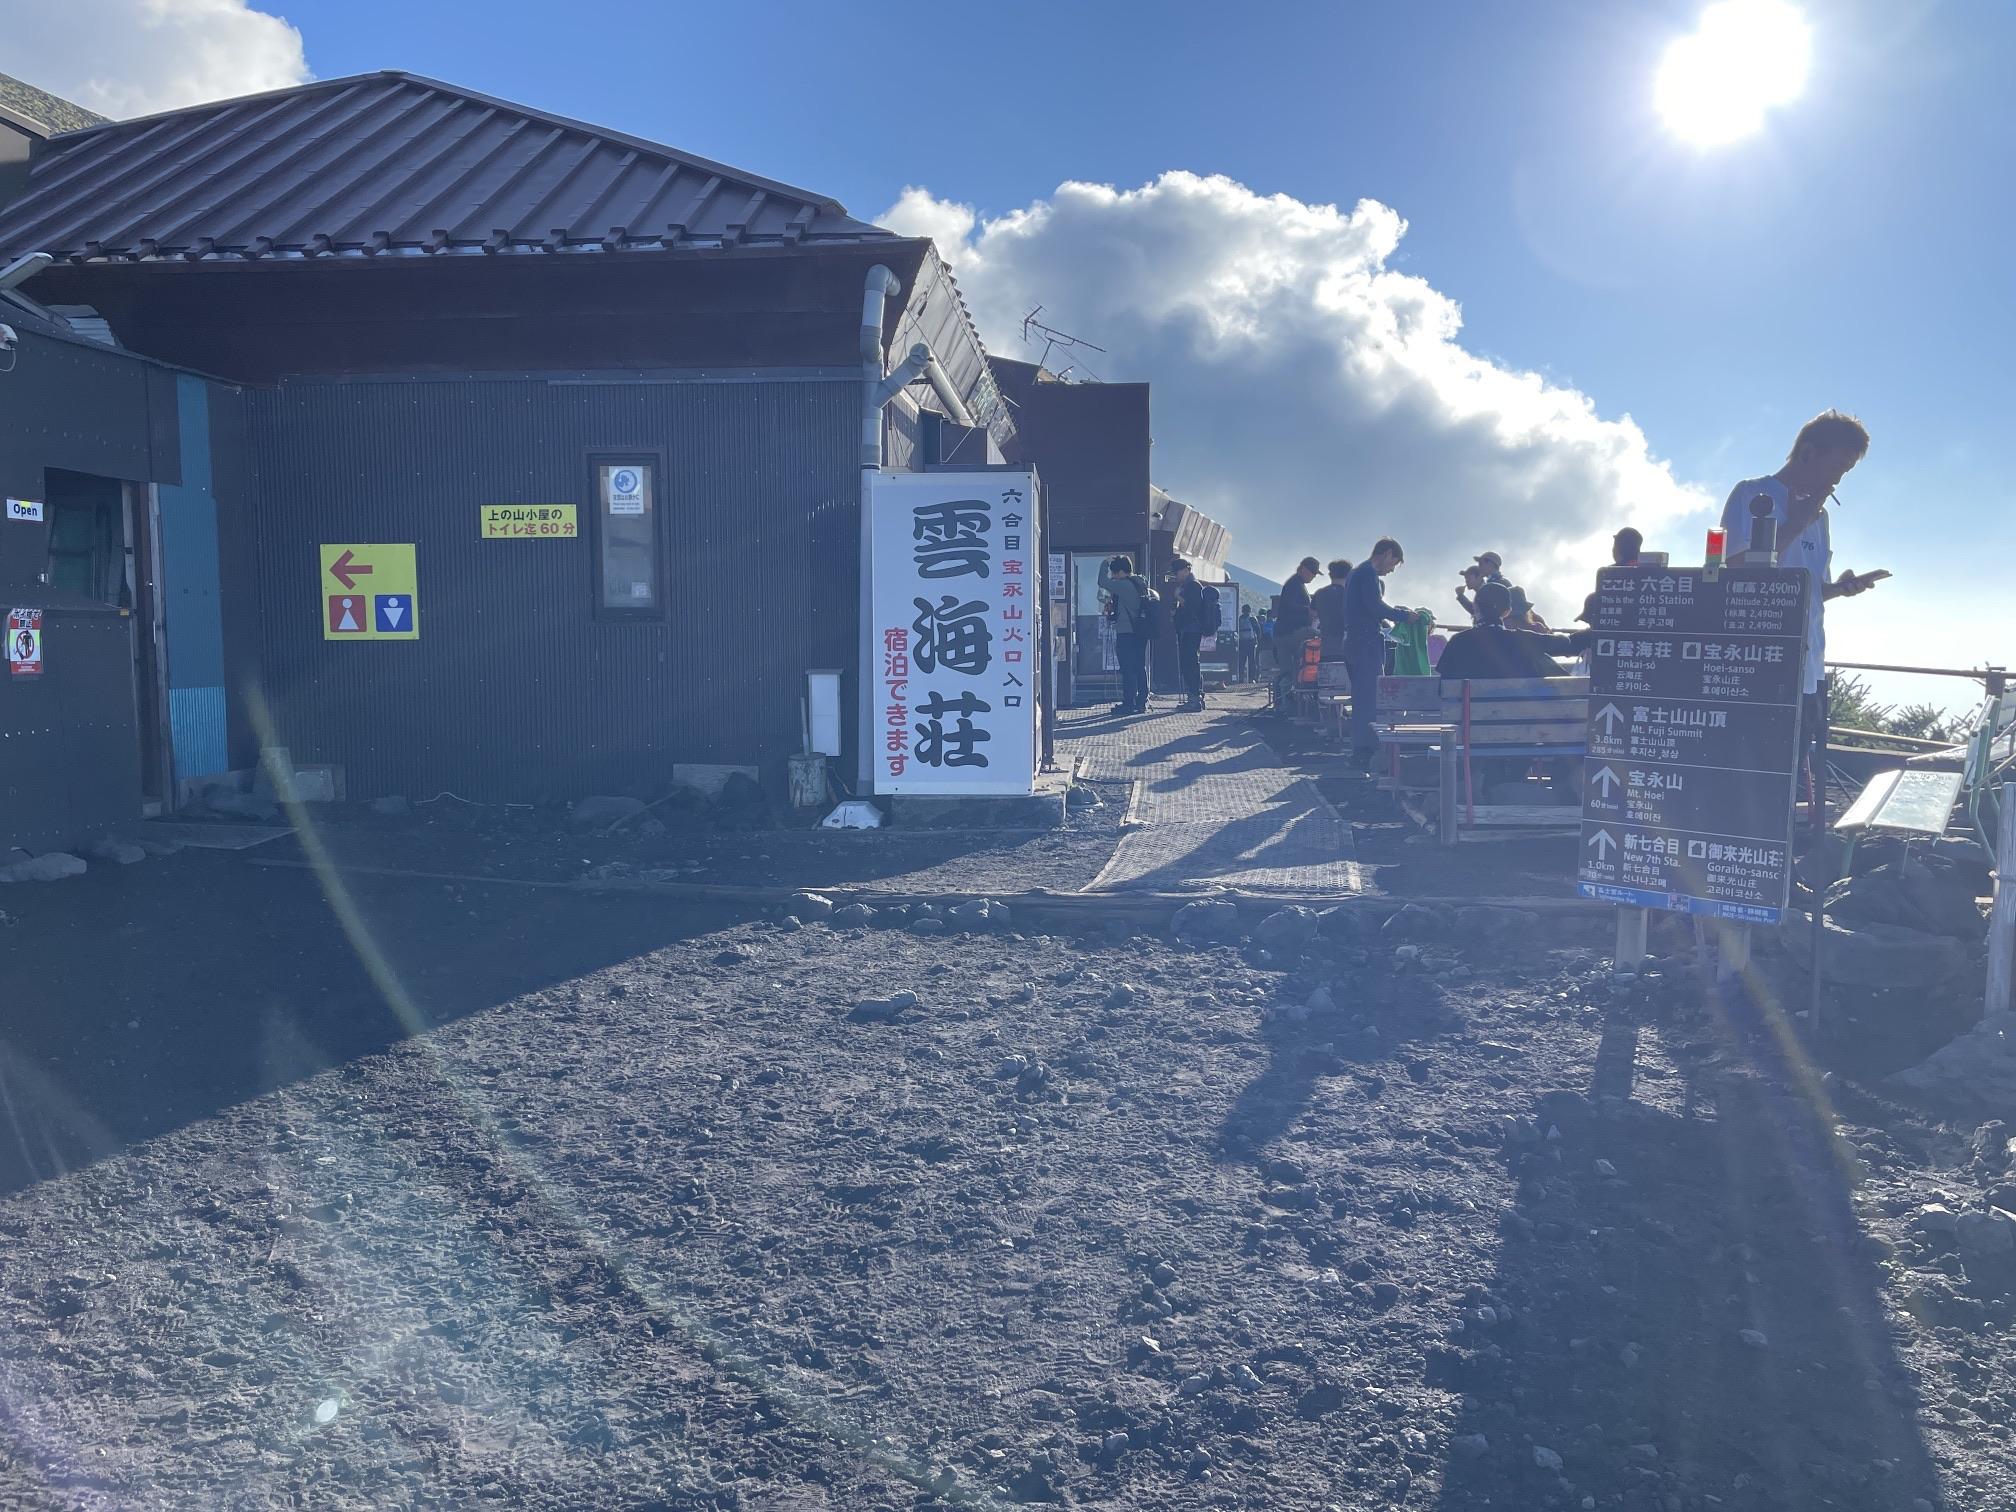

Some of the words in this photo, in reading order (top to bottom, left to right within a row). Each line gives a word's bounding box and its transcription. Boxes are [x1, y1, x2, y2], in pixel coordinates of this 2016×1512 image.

[13, 503, 38, 518] Open
[488, 508, 563, 521] 上の山小屋の
[1602, 579, 1635, 592] ここは
[1640, 576, 1693, 593] 六合目
[1001, 488, 1023, 708] 六合目宝永山火口入口
[1639, 594, 1656, 605] 6th
[1659, 594, 1694, 605] Station
[912, 499, 993, 768] 雲海荘
[1617, 640, 1673, 658] 雲海荘
[1703, 643, 1784, 663] 宝永山荘
[884, 627, 909, 777] 宿泊できます
[1632, 705, 1728, 728] 富士山山頂
[1594, 734, 1623, 745] 3.8km
[1630, 724, 1645, 734] Mt.
[1648, 725, 1665, 737] Fuji
[1667, 727, 1703, 738] Summit
[1628, 769, 1683, 791] 宝永山
[1626, 788, 1641, 798] Mt.
[1644, 790, 1665, 800] Hoei
[1624, 832, 1680, 855] 新七合目
[1623, 851, 1643, 863] New
[1646, 854, 1661, 865] 7th
[1663, 856, 1682, 868] Sta.
[1708, 842, 1784, 868] 御来光山荘
[1587, 860, 1615, 872] 1.0km
